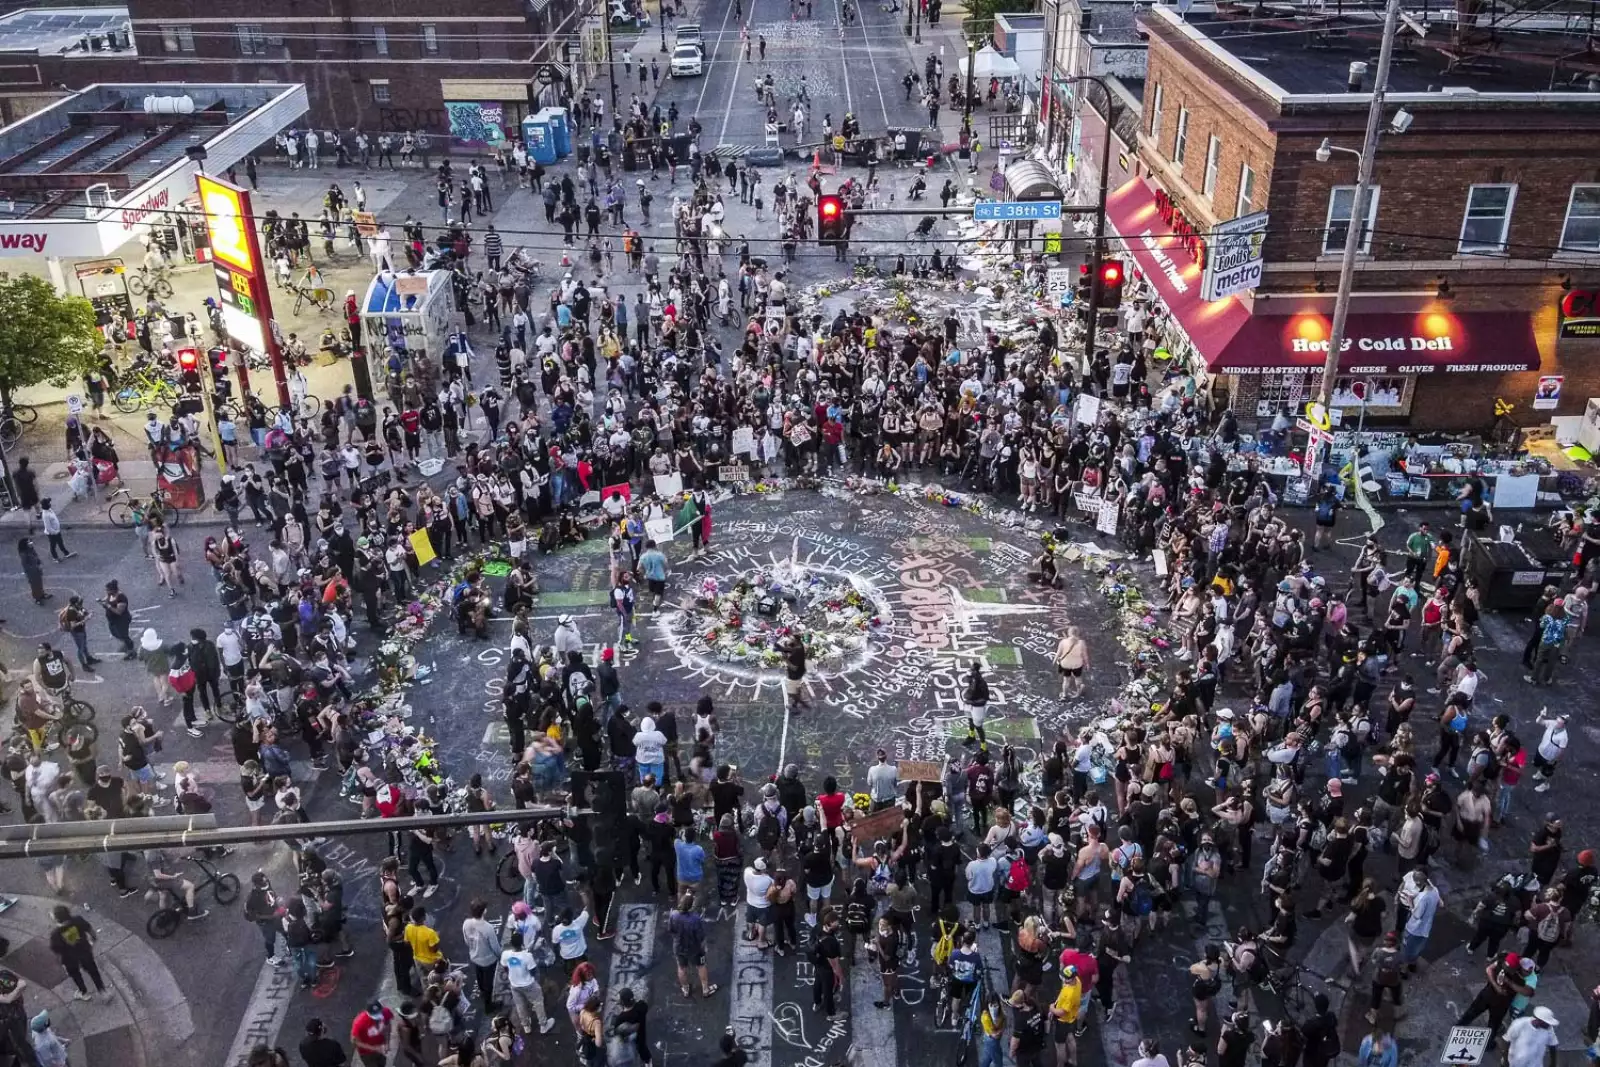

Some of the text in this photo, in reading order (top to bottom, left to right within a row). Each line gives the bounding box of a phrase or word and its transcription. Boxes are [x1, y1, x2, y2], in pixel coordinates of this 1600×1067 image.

[122, 188, 169, 232] Speedway
[993, 204, 1058, 217] E 38th St
[1216, 264, 1261, 291] metro
[1050, 282, 1068, 292] 25
[1291, 338, 1330, 352] Hot
[1358, 337, 1406, 352] Cold
[1410, 336, 1454, 352] Deli
[1221, 363, 1528, 375] MIDDLE EASTERN FO CHEESE OLIVES FRESH PRODUCE
[1027, 632, 1056, 648] YOU
[1011, 636, 1058, 662] GEOR
[842, 648, 932, 720] REMEMBER
[1451, 1036, 1486, 1046] ROUTE
[1455, 1029, 1488, 1038] TRUCK
